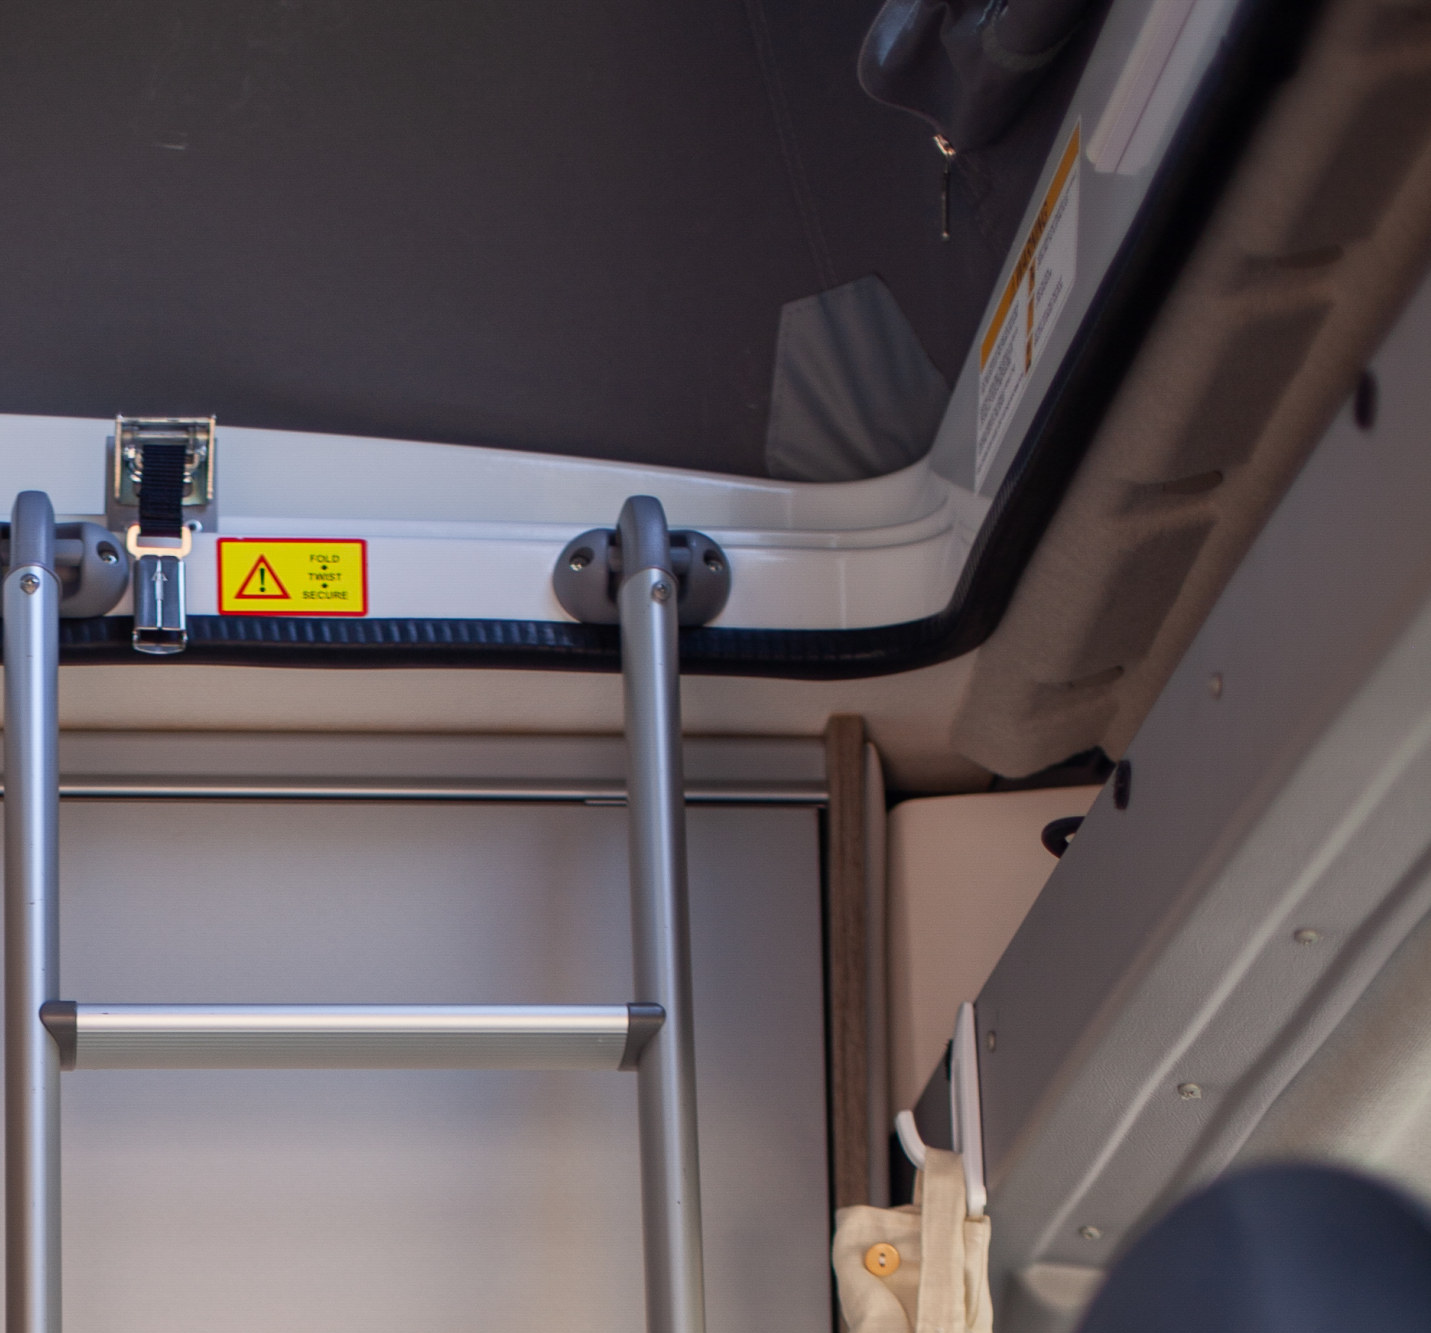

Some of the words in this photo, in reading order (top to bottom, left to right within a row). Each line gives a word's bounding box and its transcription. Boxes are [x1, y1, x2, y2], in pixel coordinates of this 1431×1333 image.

[309, 554, 340, 563] FOLD
[308, 572, 341, 581] TWIST
[302, 591, 348, 600] SECURE
